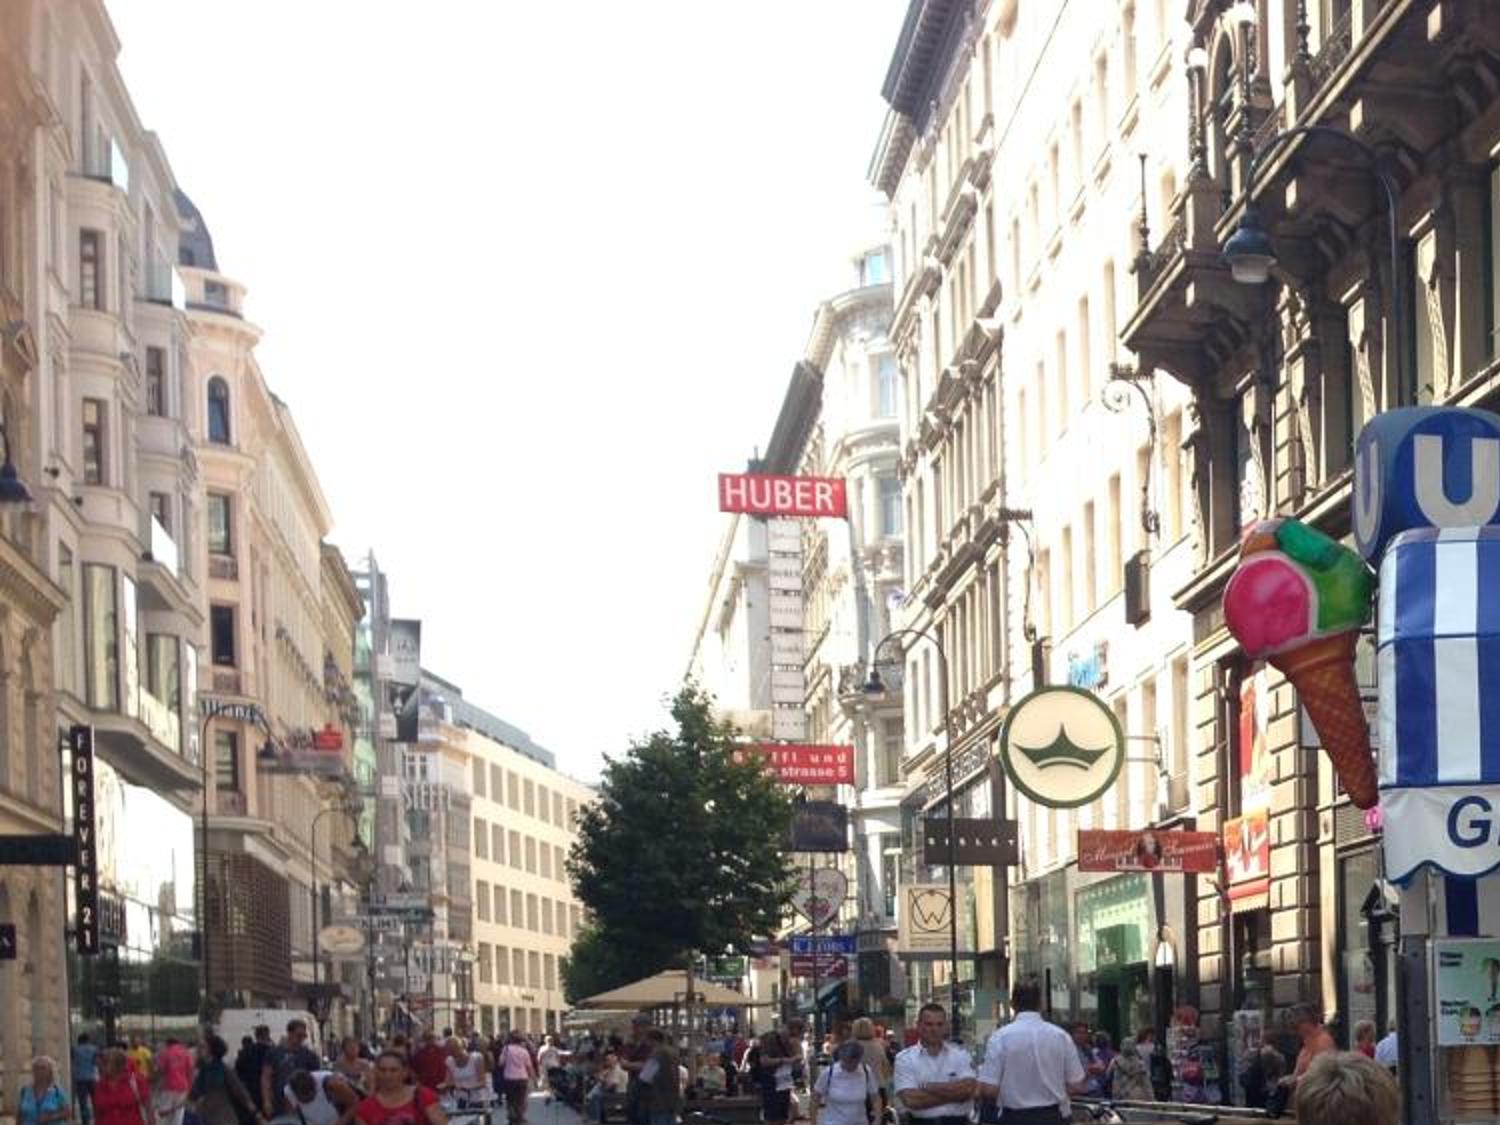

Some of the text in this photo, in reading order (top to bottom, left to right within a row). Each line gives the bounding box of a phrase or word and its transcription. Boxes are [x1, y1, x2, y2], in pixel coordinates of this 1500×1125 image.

[724, 477, 833, 511] HUBER
[1413, 433, 1500, 529] U
[809, 750, 848, 764] und
[76, 732, 92, 946] FOREVER 21
